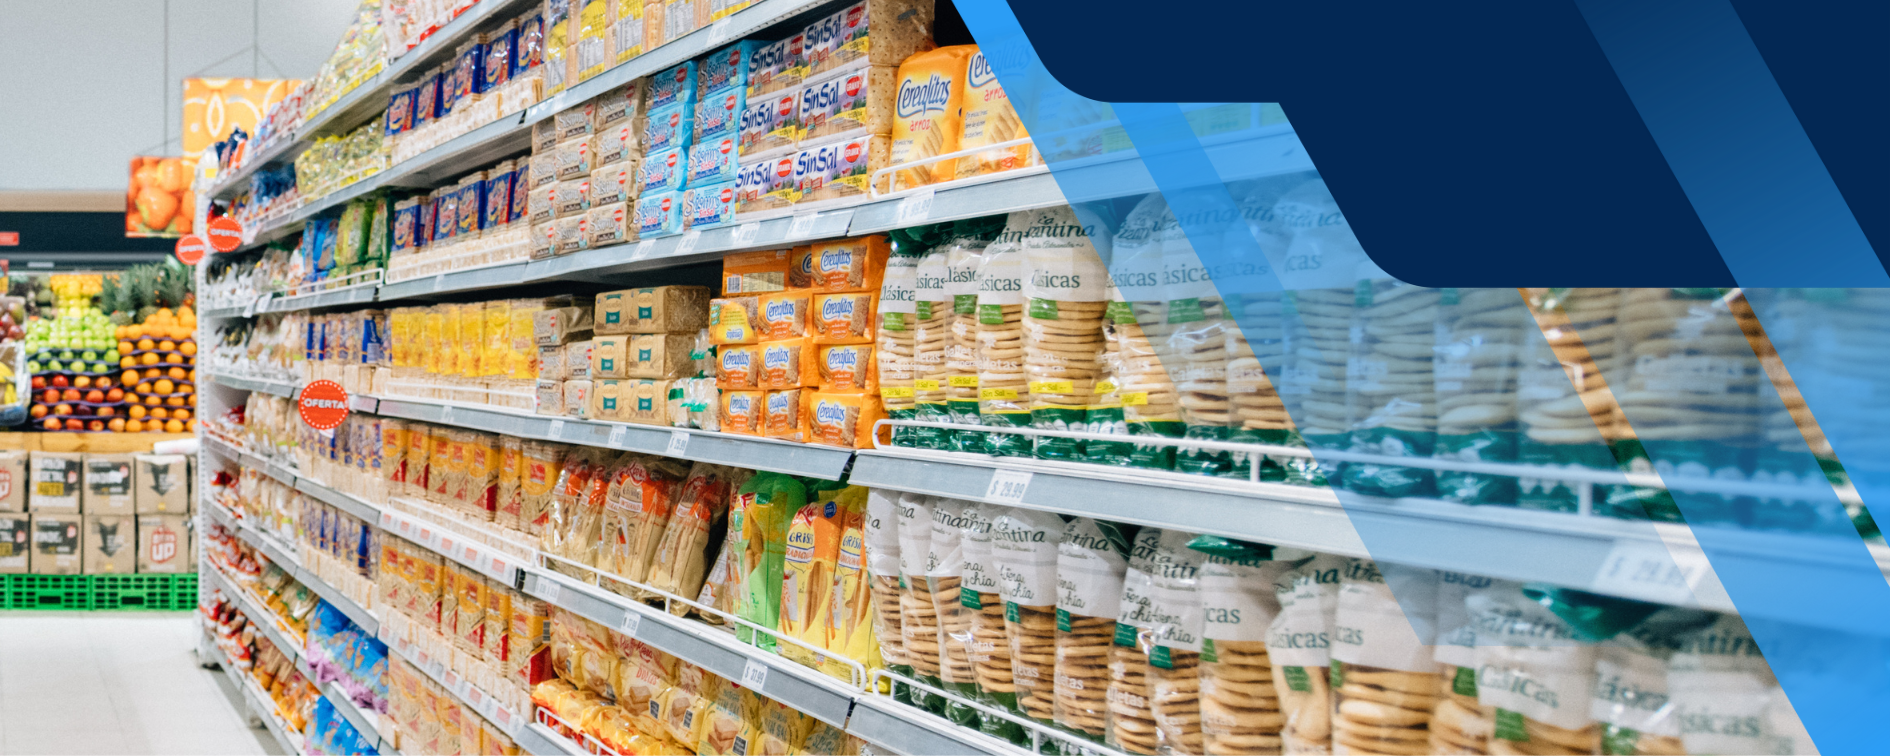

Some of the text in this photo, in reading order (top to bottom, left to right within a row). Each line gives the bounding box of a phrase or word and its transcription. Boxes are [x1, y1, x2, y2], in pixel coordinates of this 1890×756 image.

[804, 14, 842, 50] SinSal
[748, 42, 785, 73] SinSal
[802, 81, 840, 113] SinSal
[898, 74, 951, 118] Cerealitas
[739, 102, 774, 132] SinSal
[909, 118, 931, 133] arroz
[795, 147, 839, 176] SinSal
[735, 162, 773, 189] SinSal
[820, 247, 853, 272] Cerealitas
[916, 275, 946, 290] ásicas
[979, 274, 1022, 292] ásicas
[766, 298, 795, 322] Cerealitas
[822, 298, 854, 322] Cerealitas
[723, 348, 750, 371] Cerealitas
[764, 346, 790, 369] Cerealitas
[826, 347, 857, 371] Cerealitas
[303, 397, 346, 411] OFERTA
[729, 393, 750, 415] Cerealitas
[816, 400, 846, 424] Cerealitas
[990, 480, 1026, 500] $ 29.99
[151, 543, 175, 562] UP
[970, 572, 997, 588] chía
[1203, 602, 1241, 624] icas
[744, 665, 750, 678] $
